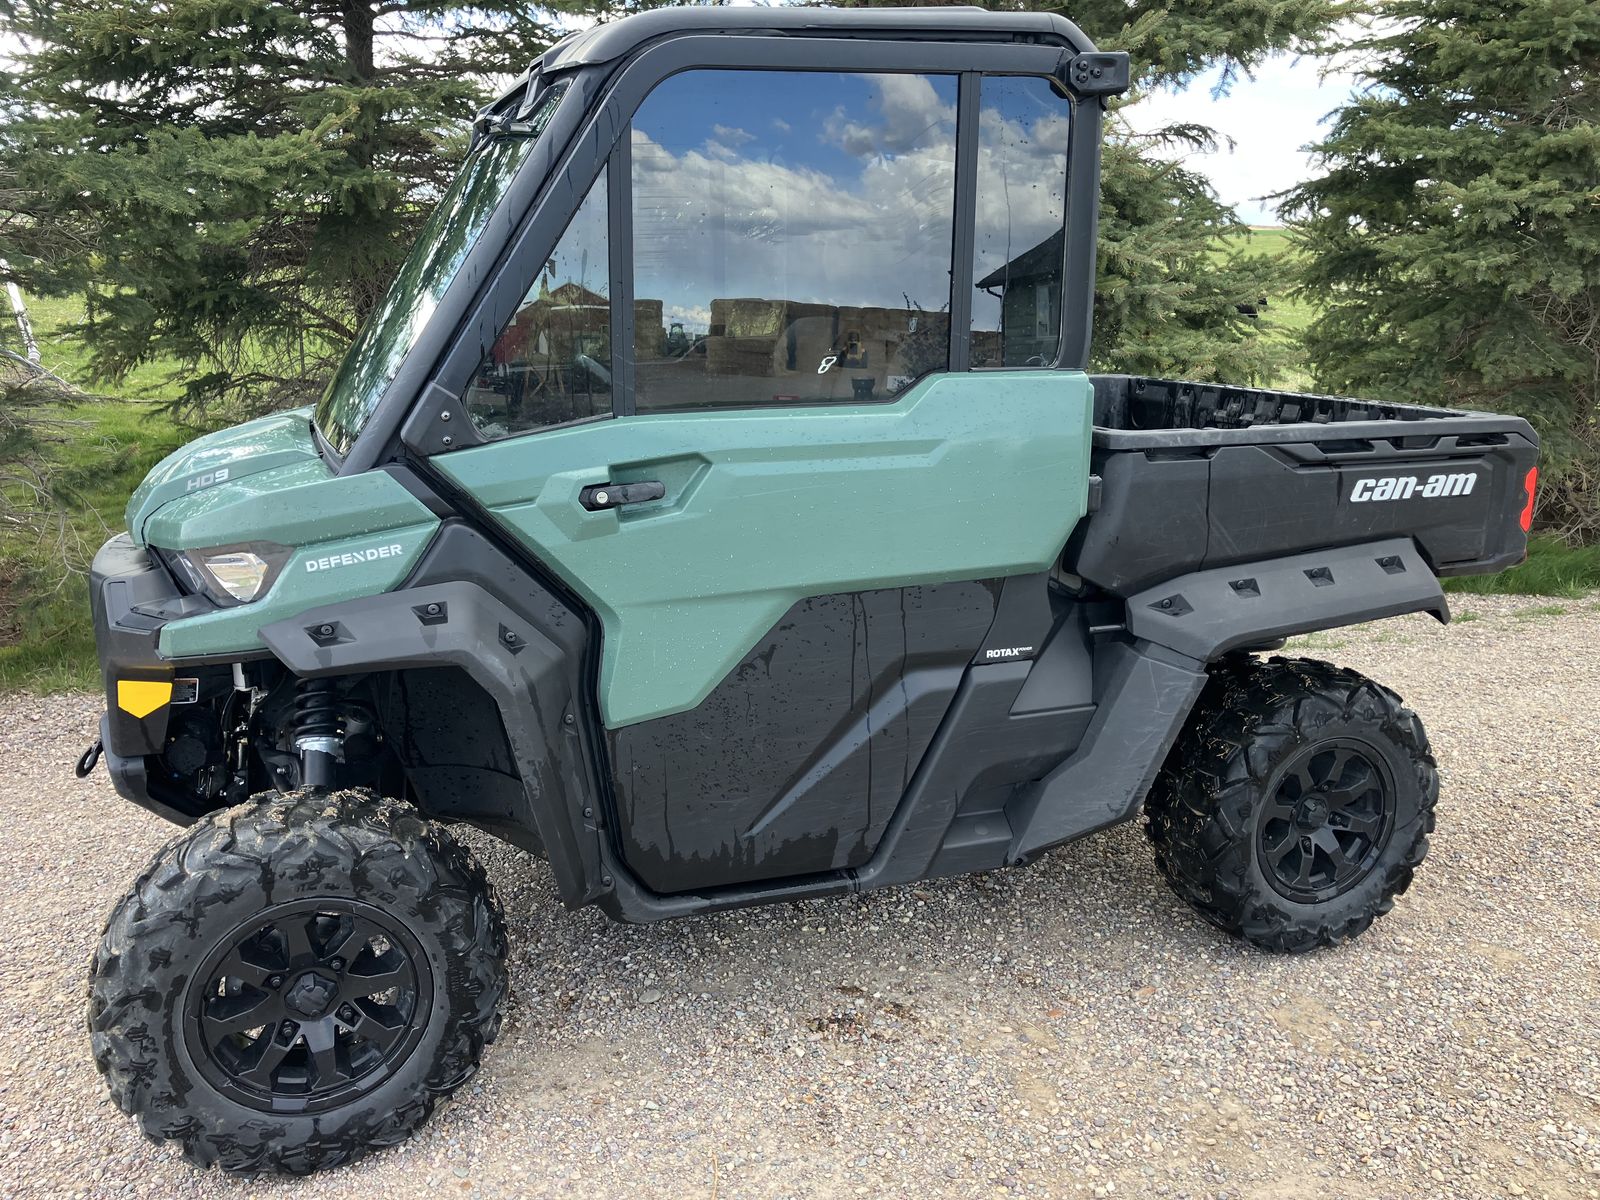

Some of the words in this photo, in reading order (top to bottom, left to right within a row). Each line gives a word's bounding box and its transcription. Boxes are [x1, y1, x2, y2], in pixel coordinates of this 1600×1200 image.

[187, 468, 229, 491] HD9
[1350, 473, 1477, 502] can-am
[305, 544, 402, 572] DEFENDER
[986, 647, 1019, 658] ROTAX
